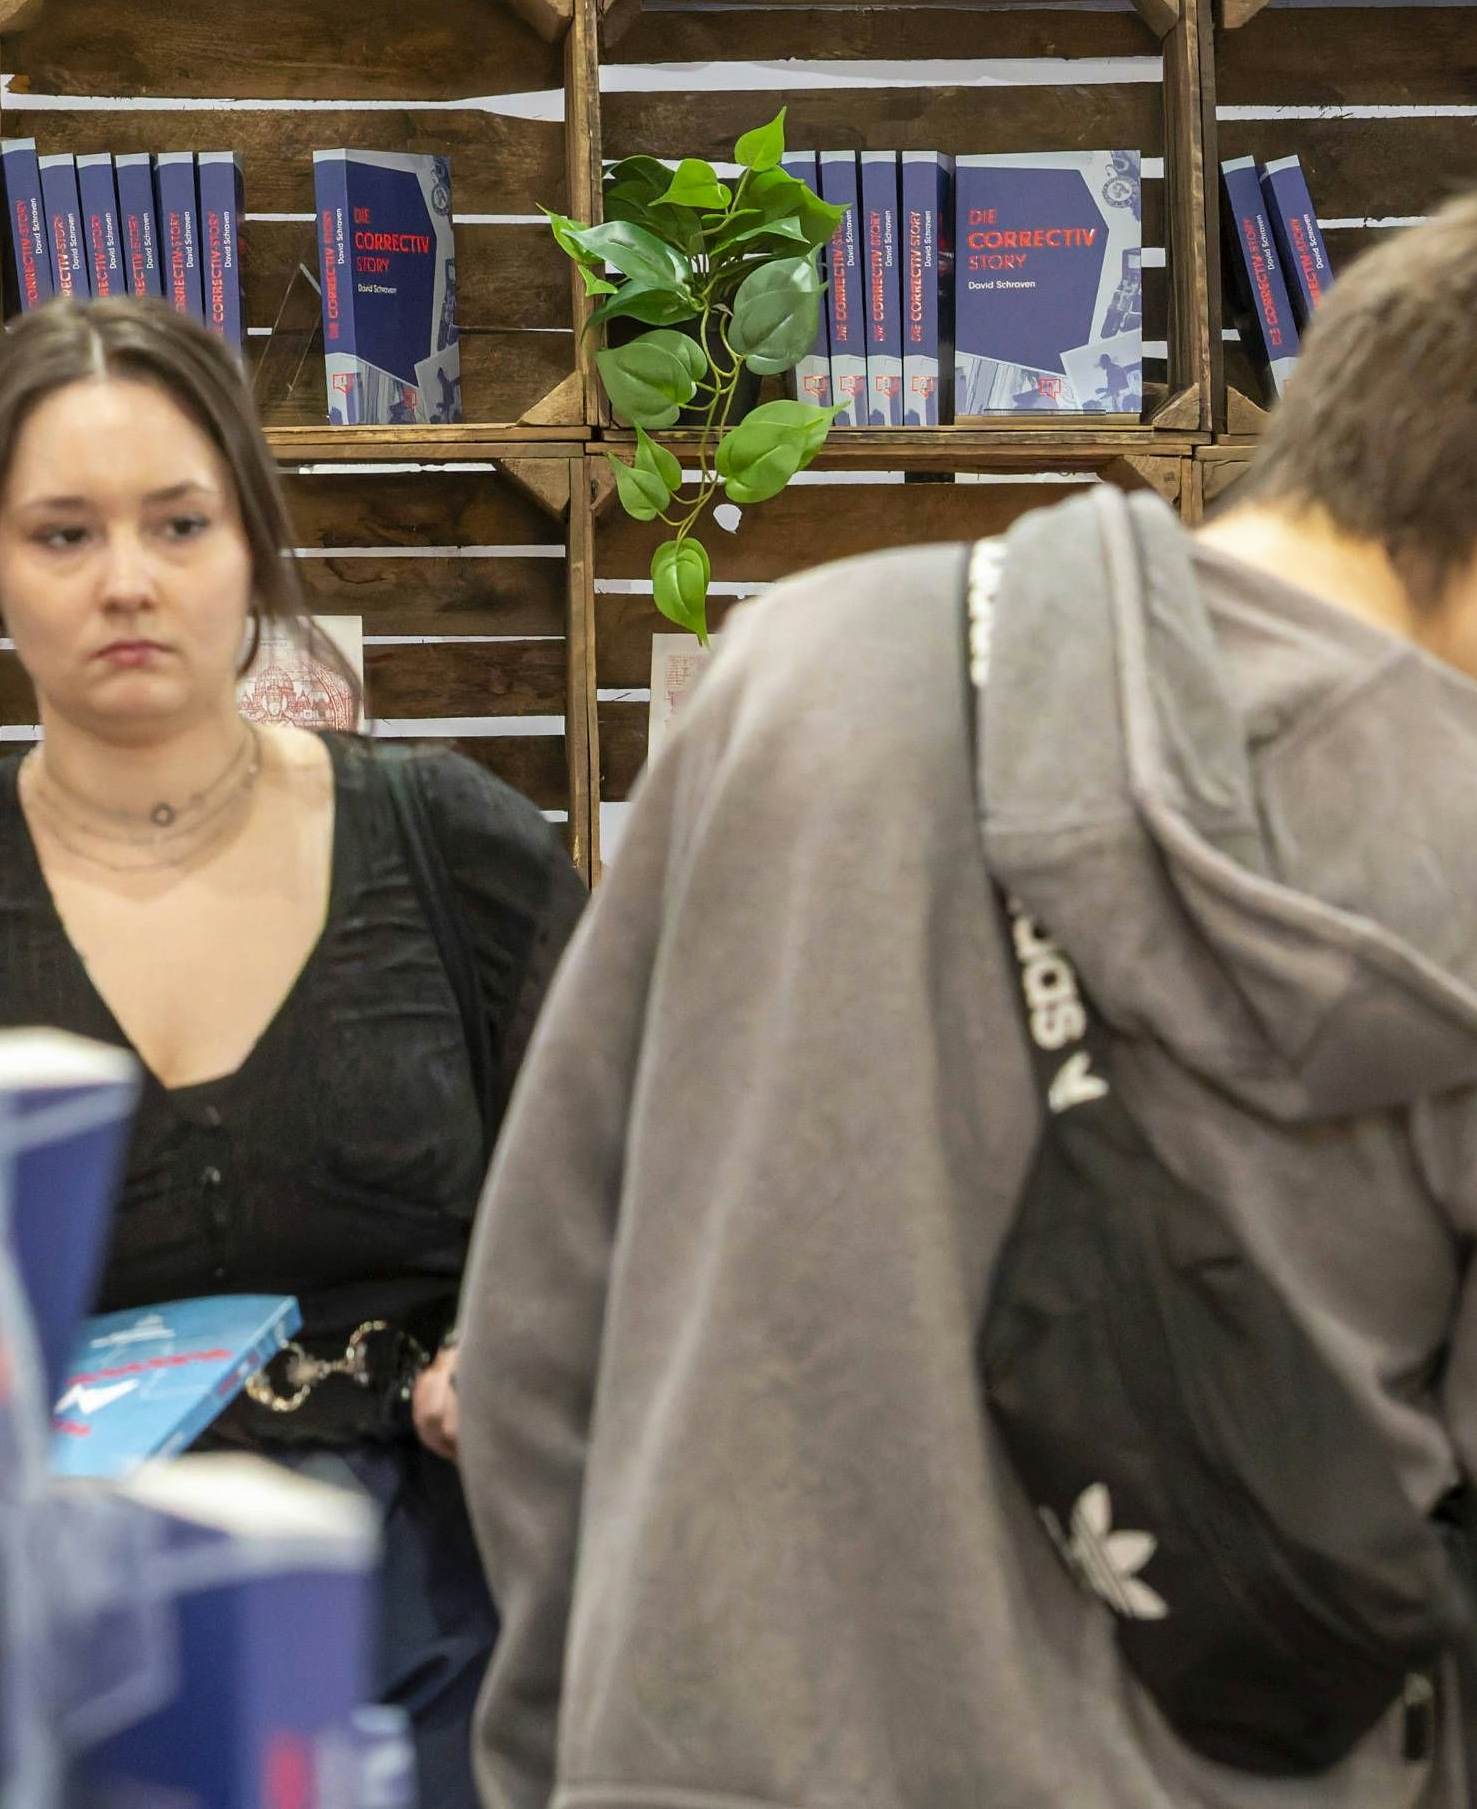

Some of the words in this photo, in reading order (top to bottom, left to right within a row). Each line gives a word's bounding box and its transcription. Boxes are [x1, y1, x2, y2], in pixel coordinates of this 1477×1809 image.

[354, 207, 370, 224] DIE
[969, 209, 996, 225] DIE
[924, 210, 932, 244] Schraven
[355, 232, 430, 253] CORRECTIV
[968, 229, 1096, 249] CORRECTIV
[356, 255, 390, 273] STORY
[924, 245, 932, 267] David
[968, 254, 1026, 270] STORY
[358, 284, 374, 292] David
[375, 285, 397, 294] Schraven
[968, 280, 994, 289] David
[996, 280, 1036, 289] Schraven
